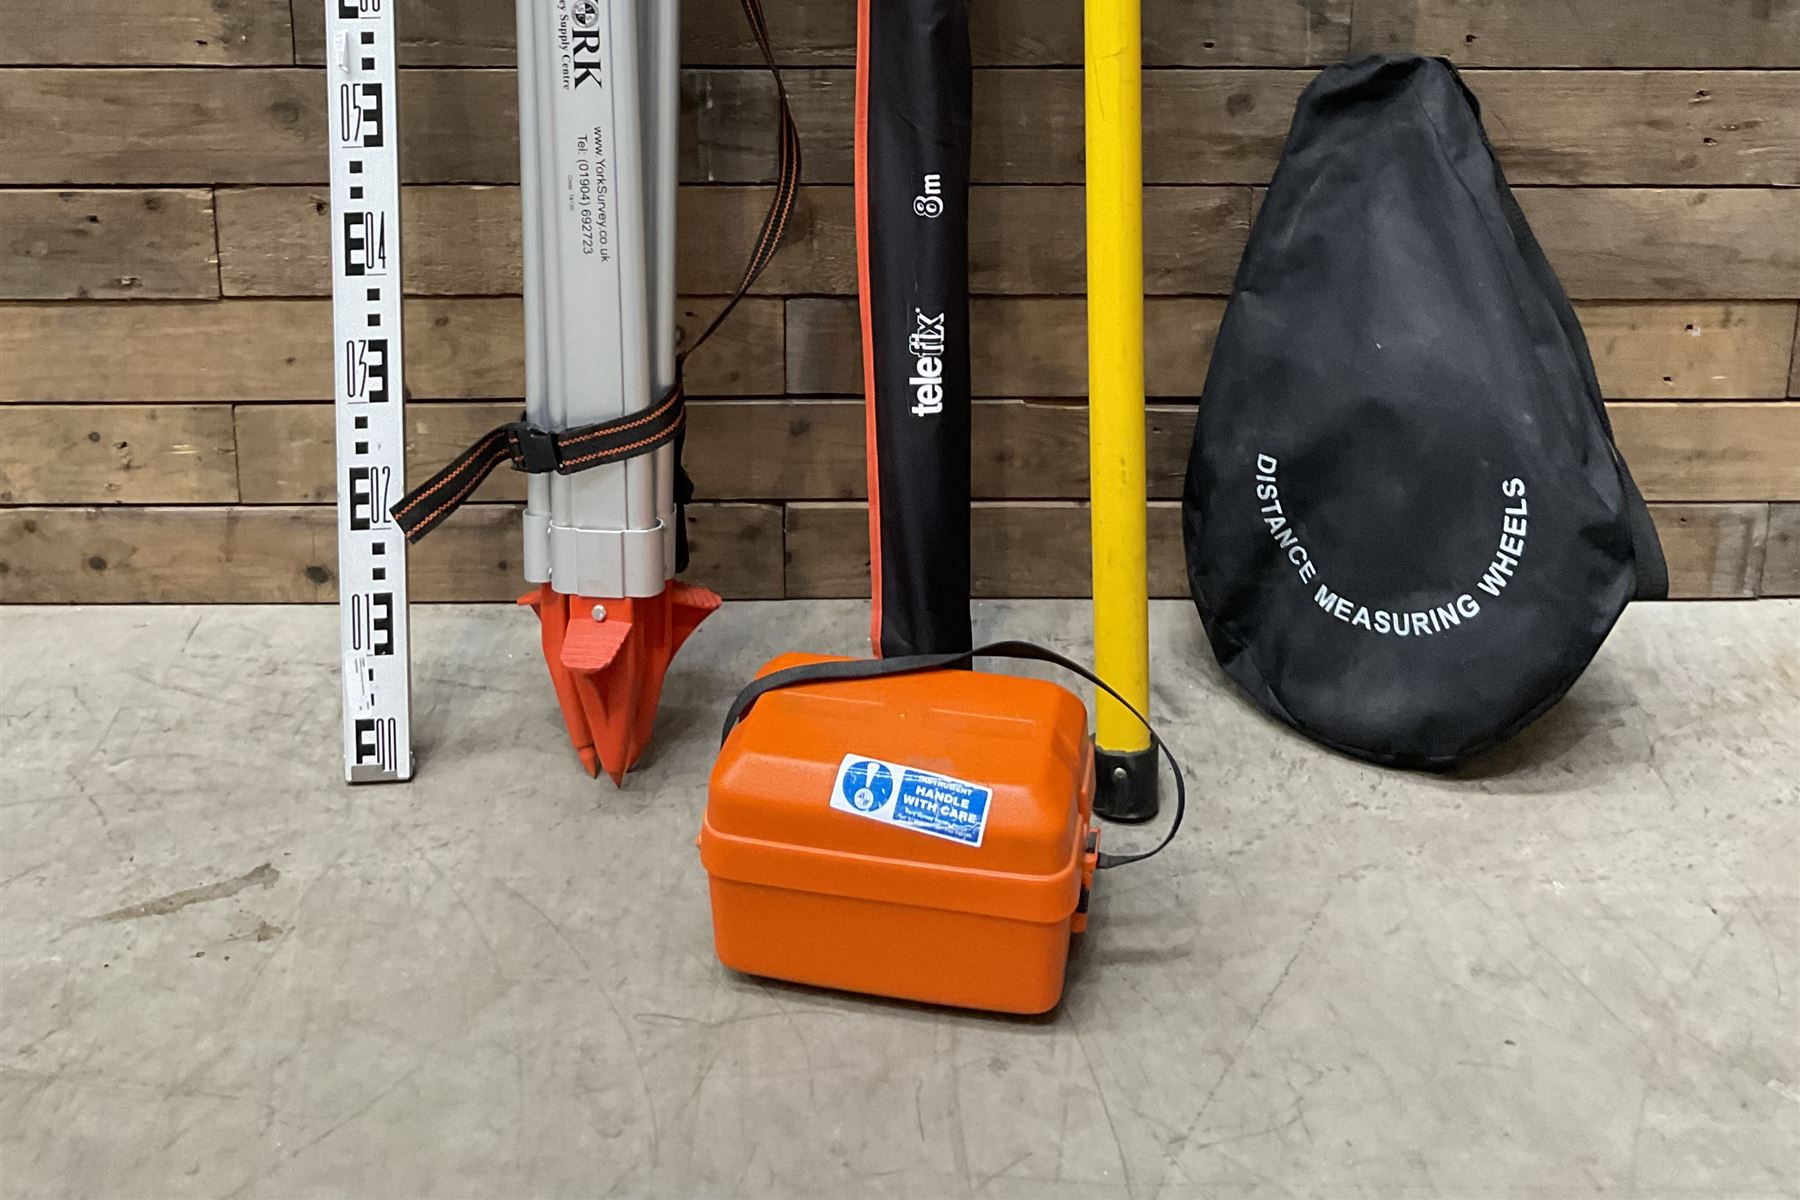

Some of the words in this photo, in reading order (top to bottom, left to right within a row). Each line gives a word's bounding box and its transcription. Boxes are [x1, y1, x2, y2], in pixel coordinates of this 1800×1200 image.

[558, 14, 570, 50] Supply
[561, 54, 571, 90] Centre
[576, 135, 588, 156] Tel:
[576, 159, 591, 207] (01904)
[593, 126, 610, 263] www.YorkSurvey.co.uk
[581, 208, 593, 255] 692723
[908, 313, 945, 417] telefix
[1256, 453, 1316, 584] DISTANCE
[1313, 584, 1481, 636] MEASURING
[1477, 477, 1528, 597] WHEELS
[903, 794, 938, 813] WITH
[940, 805, 977, 824] CARE
[915, 785, 970, 809] HANDLE
